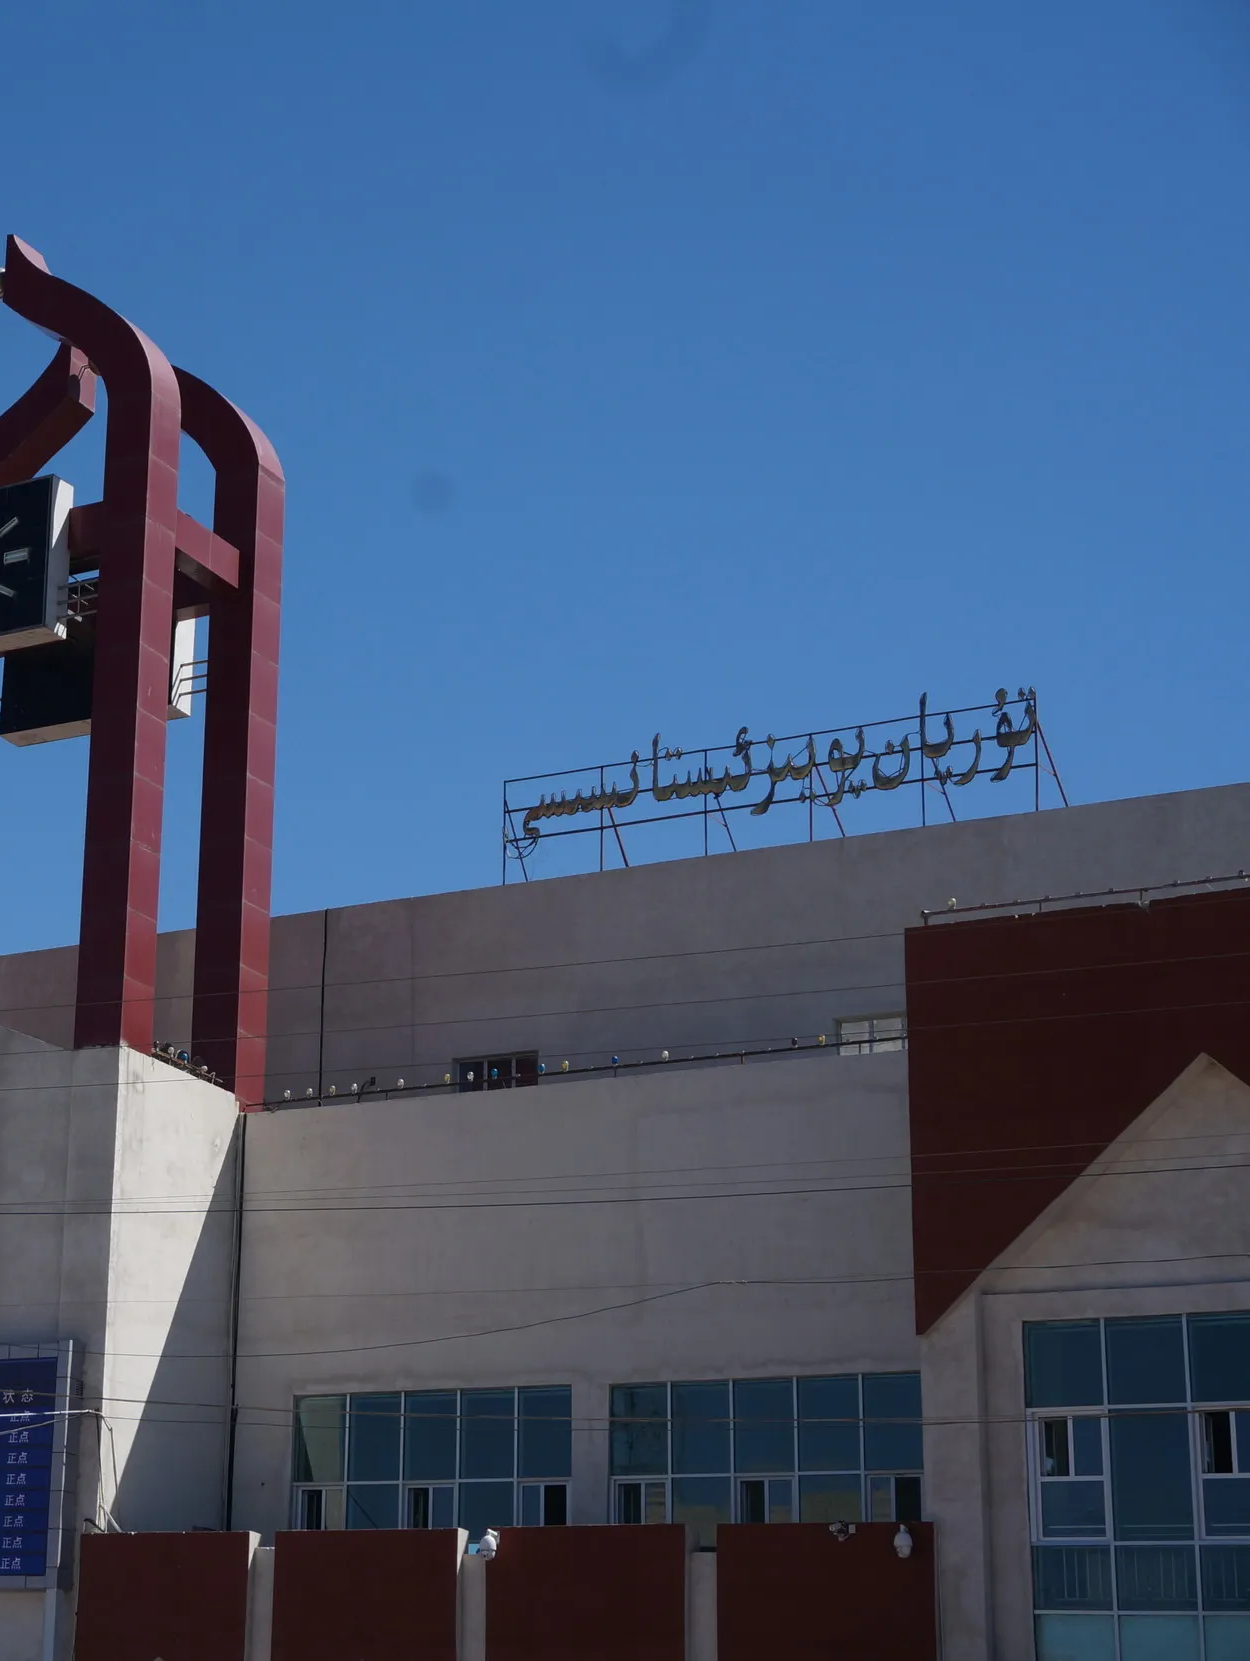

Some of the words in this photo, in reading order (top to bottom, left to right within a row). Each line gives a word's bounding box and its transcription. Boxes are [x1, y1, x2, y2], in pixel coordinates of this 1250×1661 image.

[8, 1431, 29, 1444] 正点
[7, 1452, 28, 1465] 正点
[5, 1473, 27, 1485] 正点
[4, 1494, 26, 1506] 正点
[3, 1515, 24, 1528] 正点
[2, 1536, 23, 1549] 正点
[0, 1556, 22, 1570] 正点
